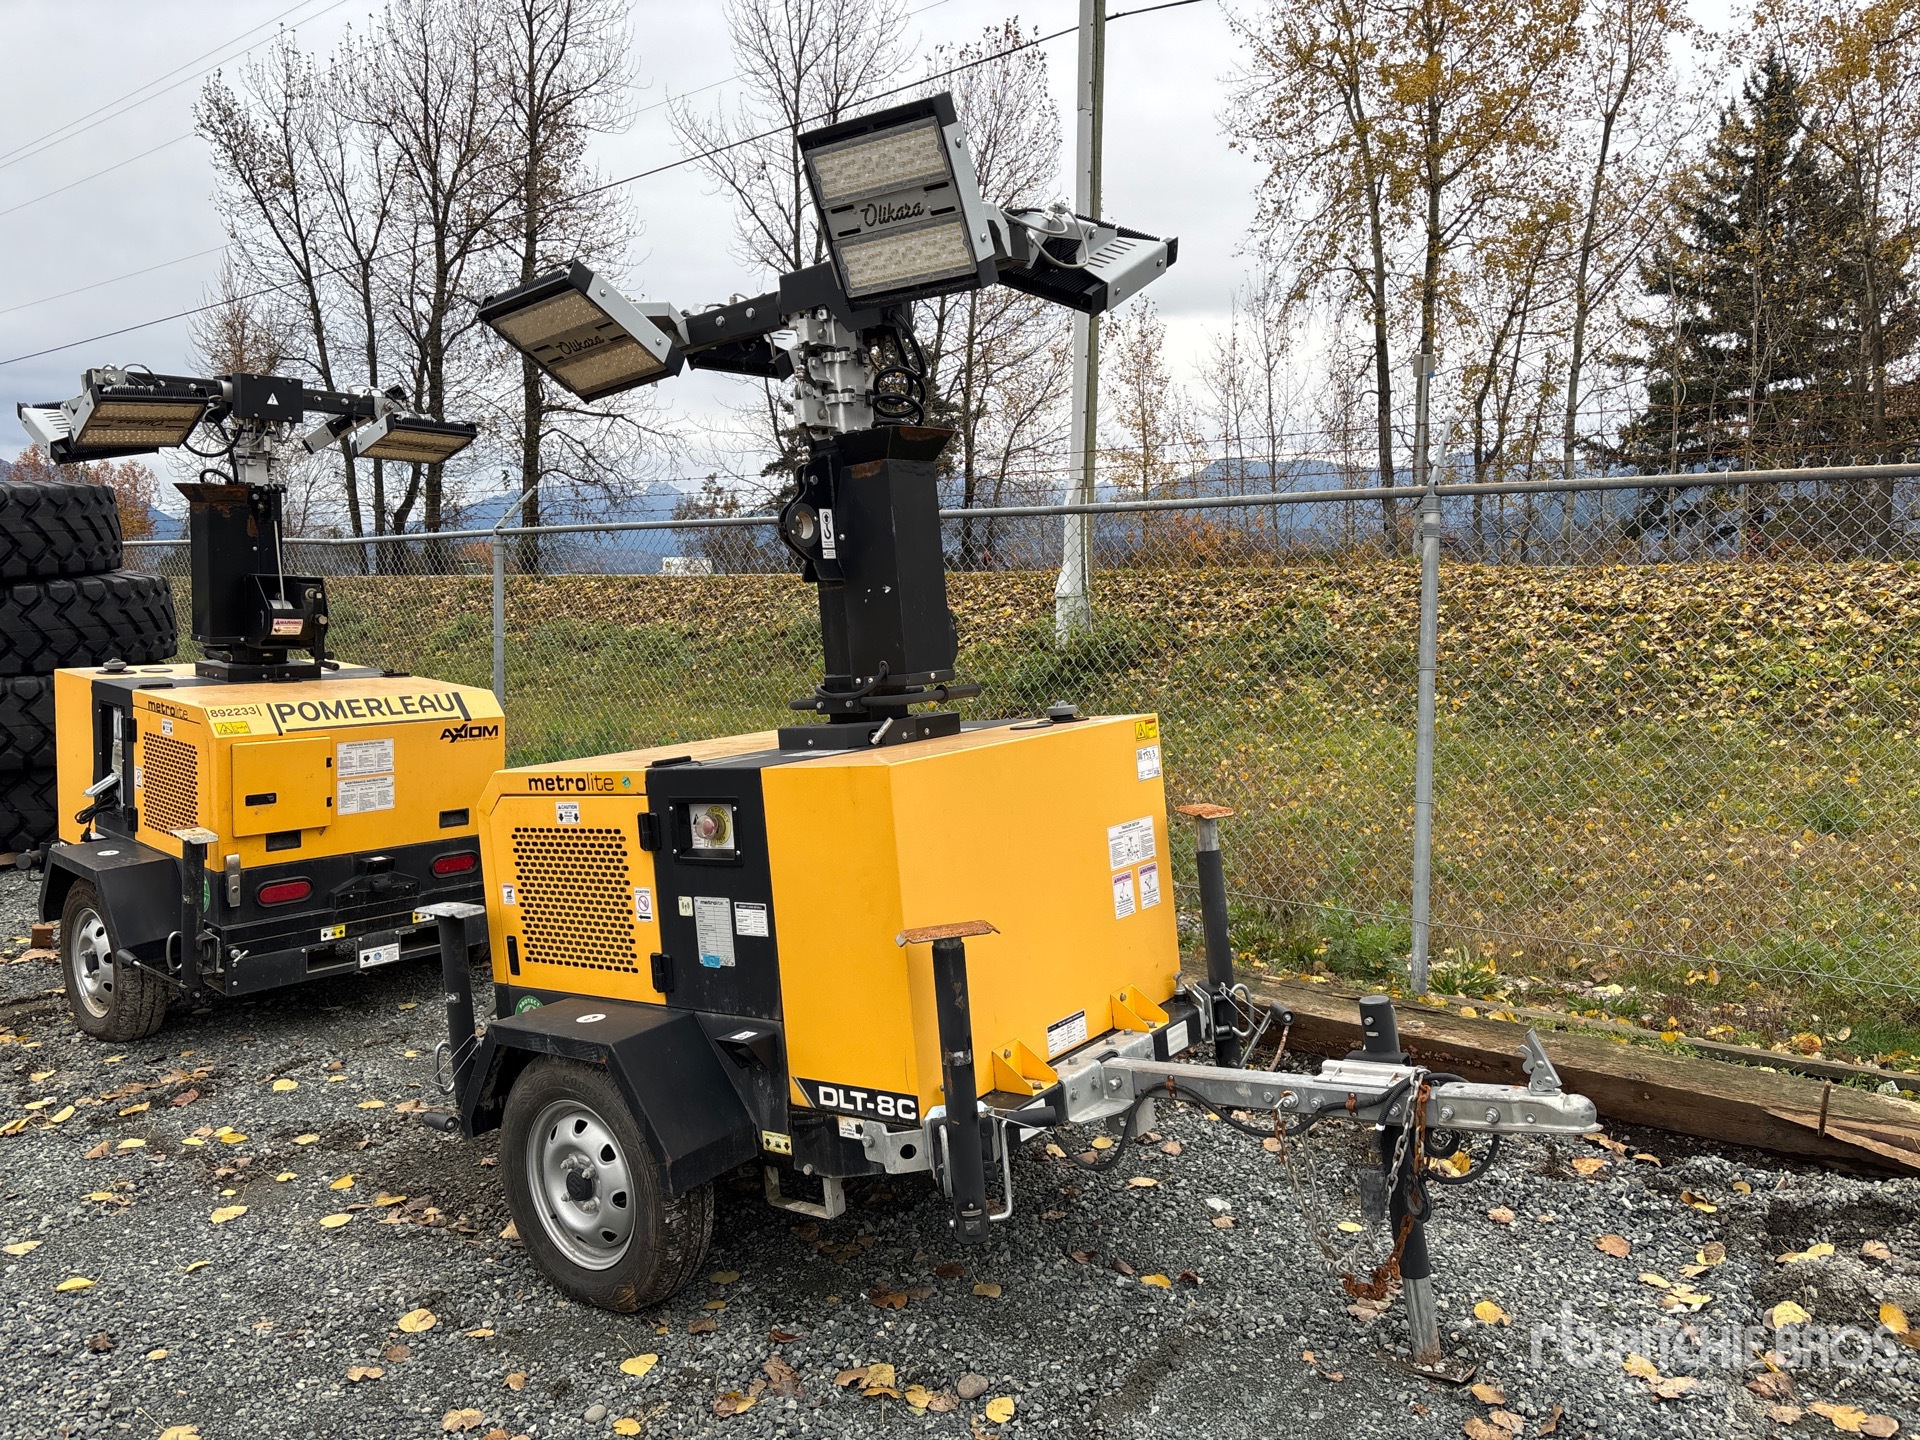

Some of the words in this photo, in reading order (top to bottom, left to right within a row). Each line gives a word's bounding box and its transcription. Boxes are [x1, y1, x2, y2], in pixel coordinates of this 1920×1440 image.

[147, 700, 189, 720] metrolite
[209, 706, 257, 718] 892233
[274, 692, 456, 723] POMERLEAU
[439, 723, 499, 744] AXIOM
[527, 772, 615, 792] metrolite
[518, 997, 540, 1010] PROTECT
[818, 1085, 917, 1120] DLT-8C
